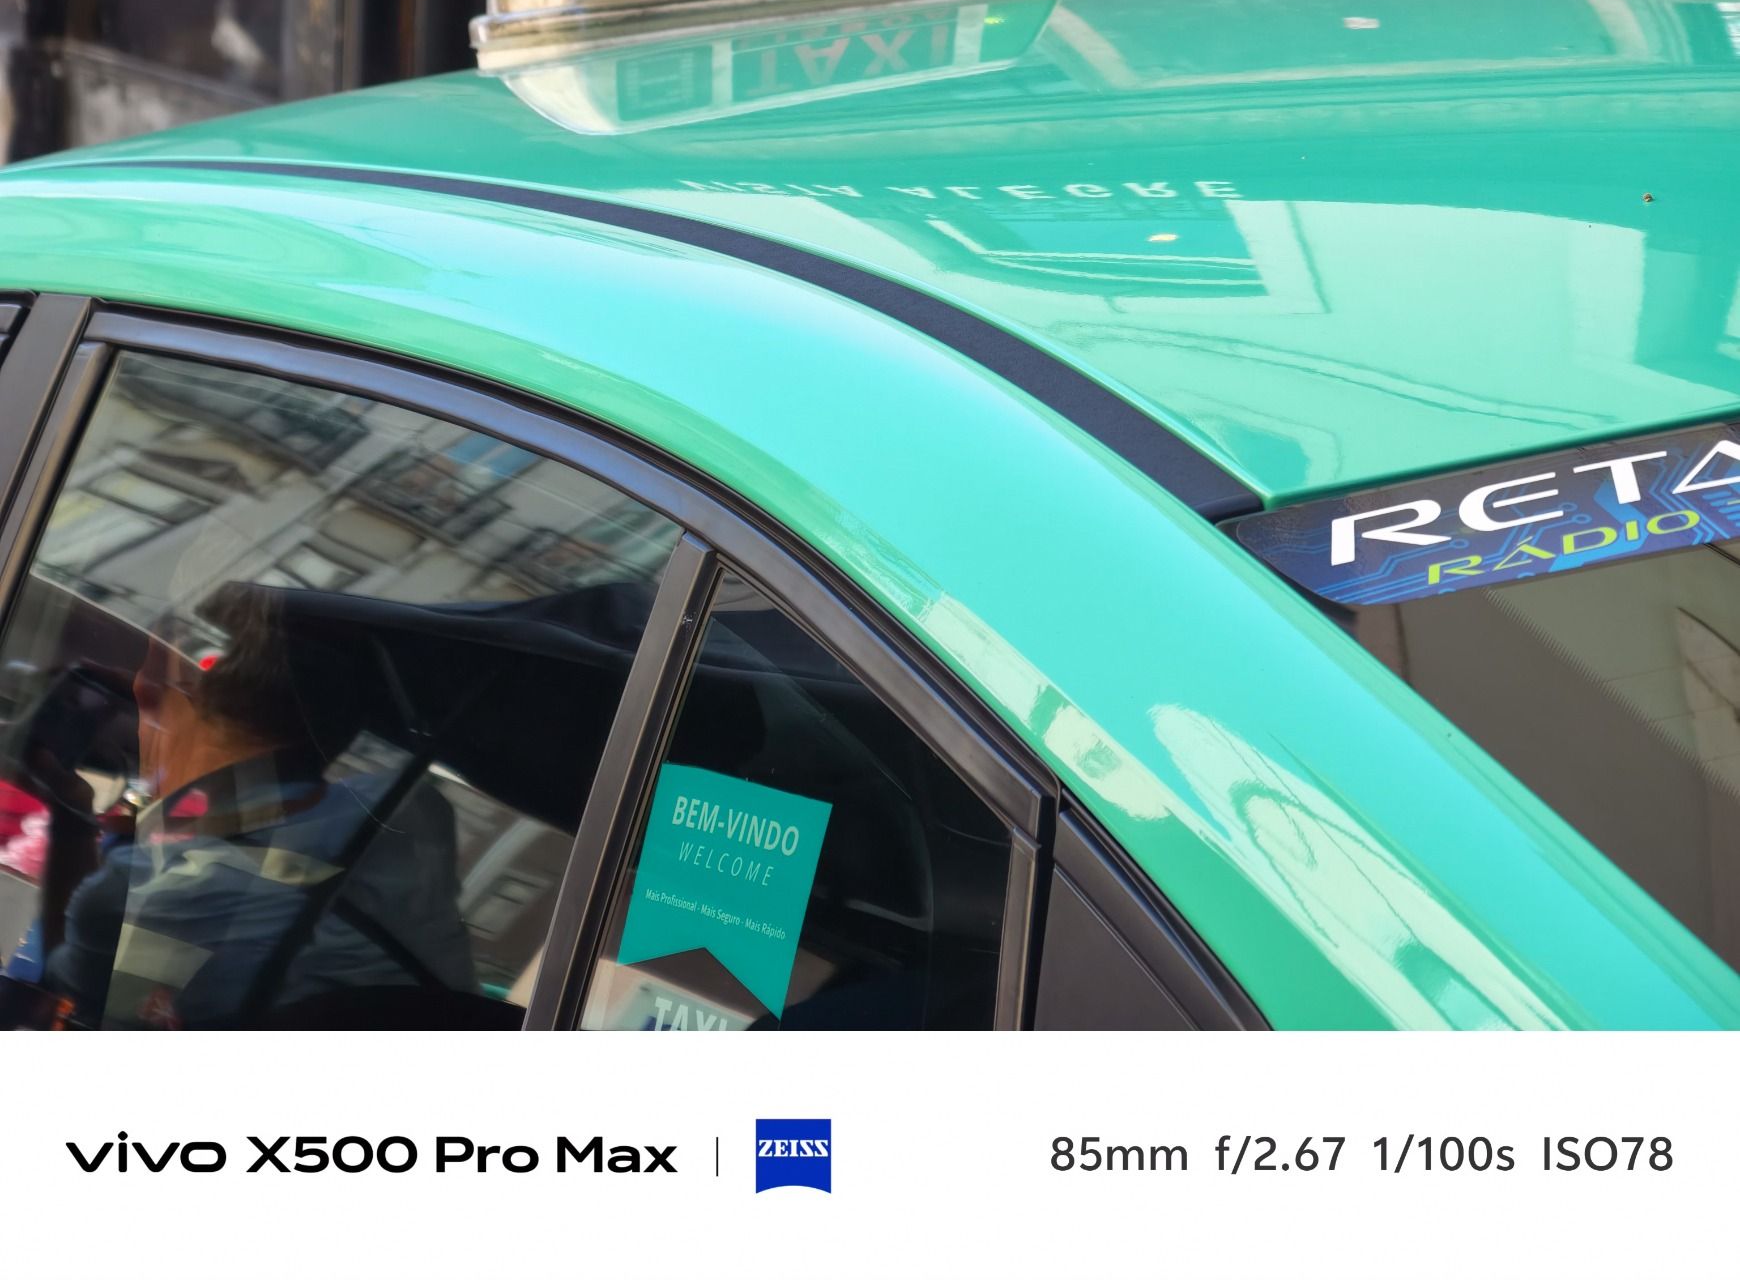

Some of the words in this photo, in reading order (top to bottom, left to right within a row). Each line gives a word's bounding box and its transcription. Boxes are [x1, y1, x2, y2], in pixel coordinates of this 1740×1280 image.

[1427, 509, 1701, 586] RÁDIO
[671, 795, 800, 856] BEM-VINDO
[678, 841, 775, 887] WELCOME
[645, 888, 660, 902] Mais
[660, 892, 698, 912] Profissional
[700, 904, 717, 919] Mais
[716, 909, 741, 926] Seguro
[744, 918, 761, 932] Mais
[761, 923, 786, 939] Rápido
